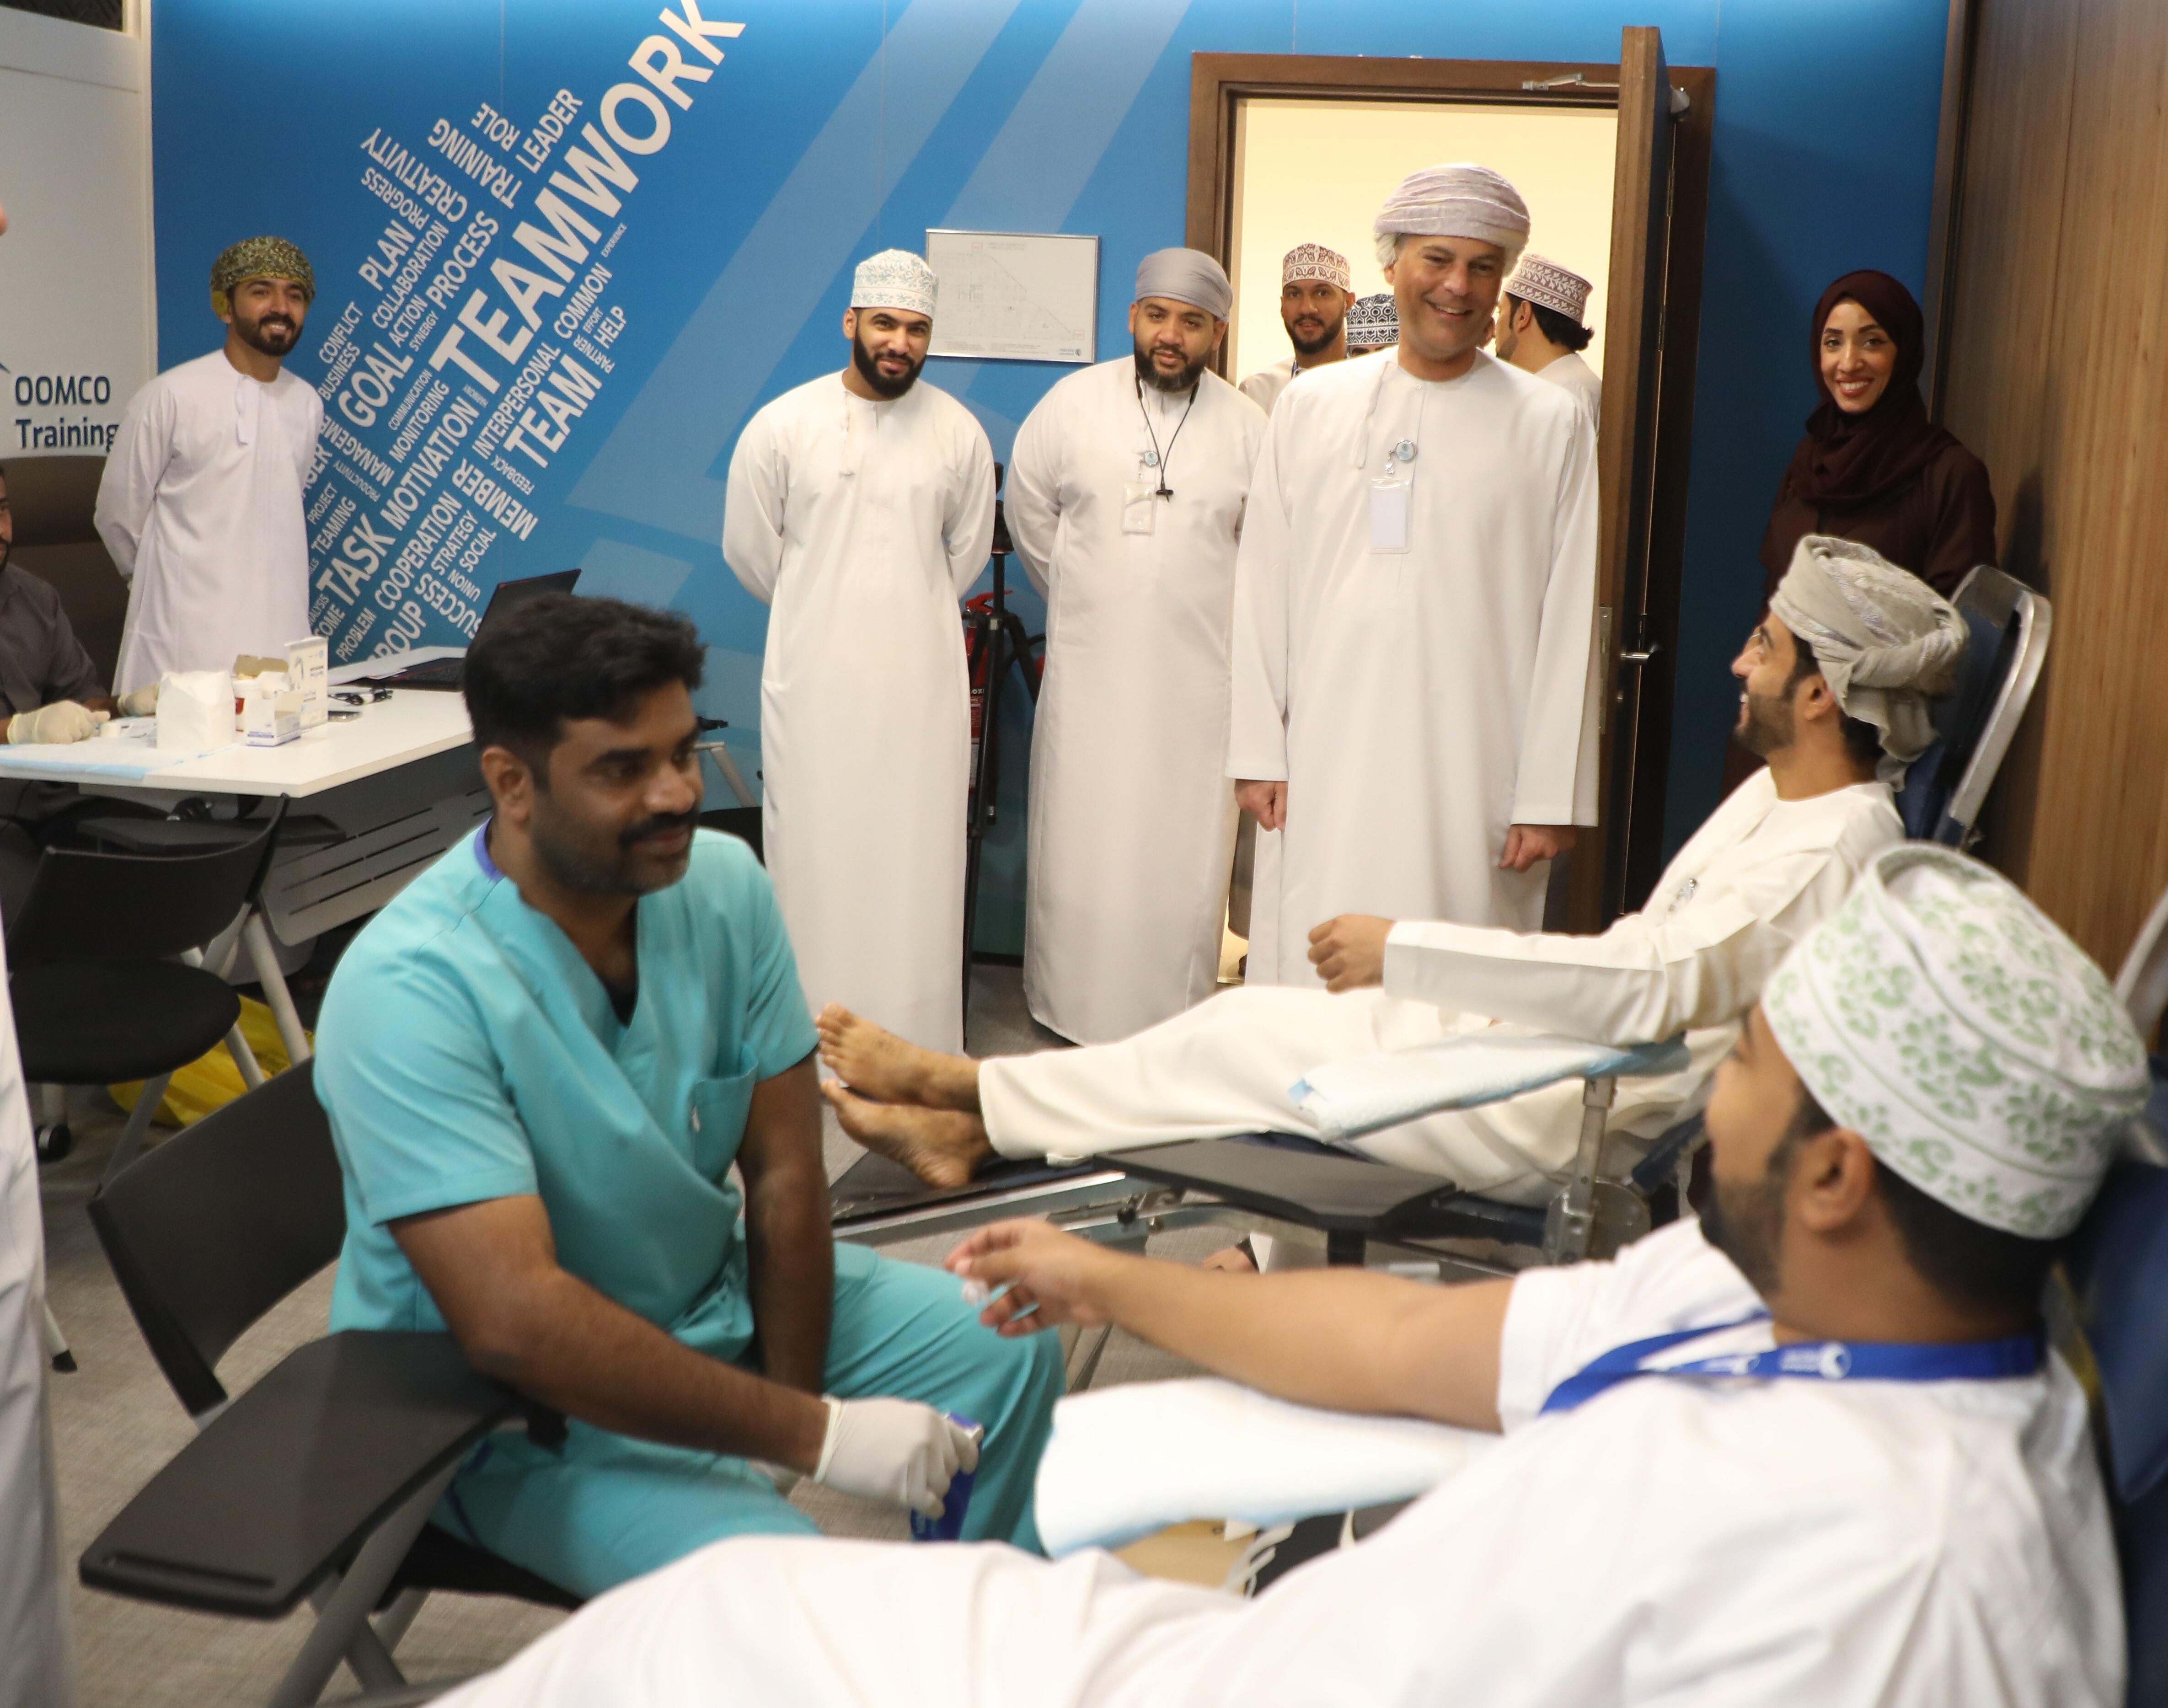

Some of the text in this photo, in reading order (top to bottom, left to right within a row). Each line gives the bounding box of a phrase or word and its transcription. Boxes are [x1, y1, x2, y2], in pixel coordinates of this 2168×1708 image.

[471, 102, 520, 151] ROLE
[515, 89, 583, 174] LEADER
[360, 128, 468, 223] CREATIVITY
[427, 118, 522, 209] TRAINING
[361, 167, 429, 230] PROGRESS
[428, 0, 747, 394] TEAMWORK
[358, 220, 415, 291] PLAN
[426, 210, 499, 310] PROCESS
[600, 222, 627, 257] EXPERIENCE
[372, 220, 450, 328] COLLABORATION
[553, 262, 613, 339] COMMON
[319, 301, 363, 364] CONFLICT
[388, 294, 428, 348] ACTION
[409, 311, 439, 352] SYNERGY
[582, 306, 604, 334] EFFORT
[594, 305, 627, 349] HELP
[319, 342, 360, 401] BUSINESS
[338, 342, 414, 427] GOAL
[573, 334, 615, 374] PARTNER
[15, 376, 111, 406] OOMCO
[388, 369, 433, 431] COMMUNICATION
[389, 380, 450, 463] MONITORING
[472, 342, 561, 460] INTERPERSONAL
[503, 354, 602, 468] TEAM
[15, 417, 119, 453] Training
[320, 415, 395, 487] MANAGEME
[380, 396, 480, 531] MOTIVATION
[307, 482, 338, 525] PROJECT
[333, 460, 381, 502] PRODUCTIVITY
[452, 458, 539, 541] MEMBER
[490, 455, 535, 495] FEEDBACK
[311, 496, 357, 555] TEAMING
[374, 491, 462, 610] COOPERATION
[431, 509, 479, 576] STRATEGY
[459, 527, 497, 573] SOCIAL
[316, 513, 396, 606] TASK
[447, 569, 481, 602] UNION
[336, 607, 377, 662] PROBLEM
[367, 600, 427, 660] ROUP
